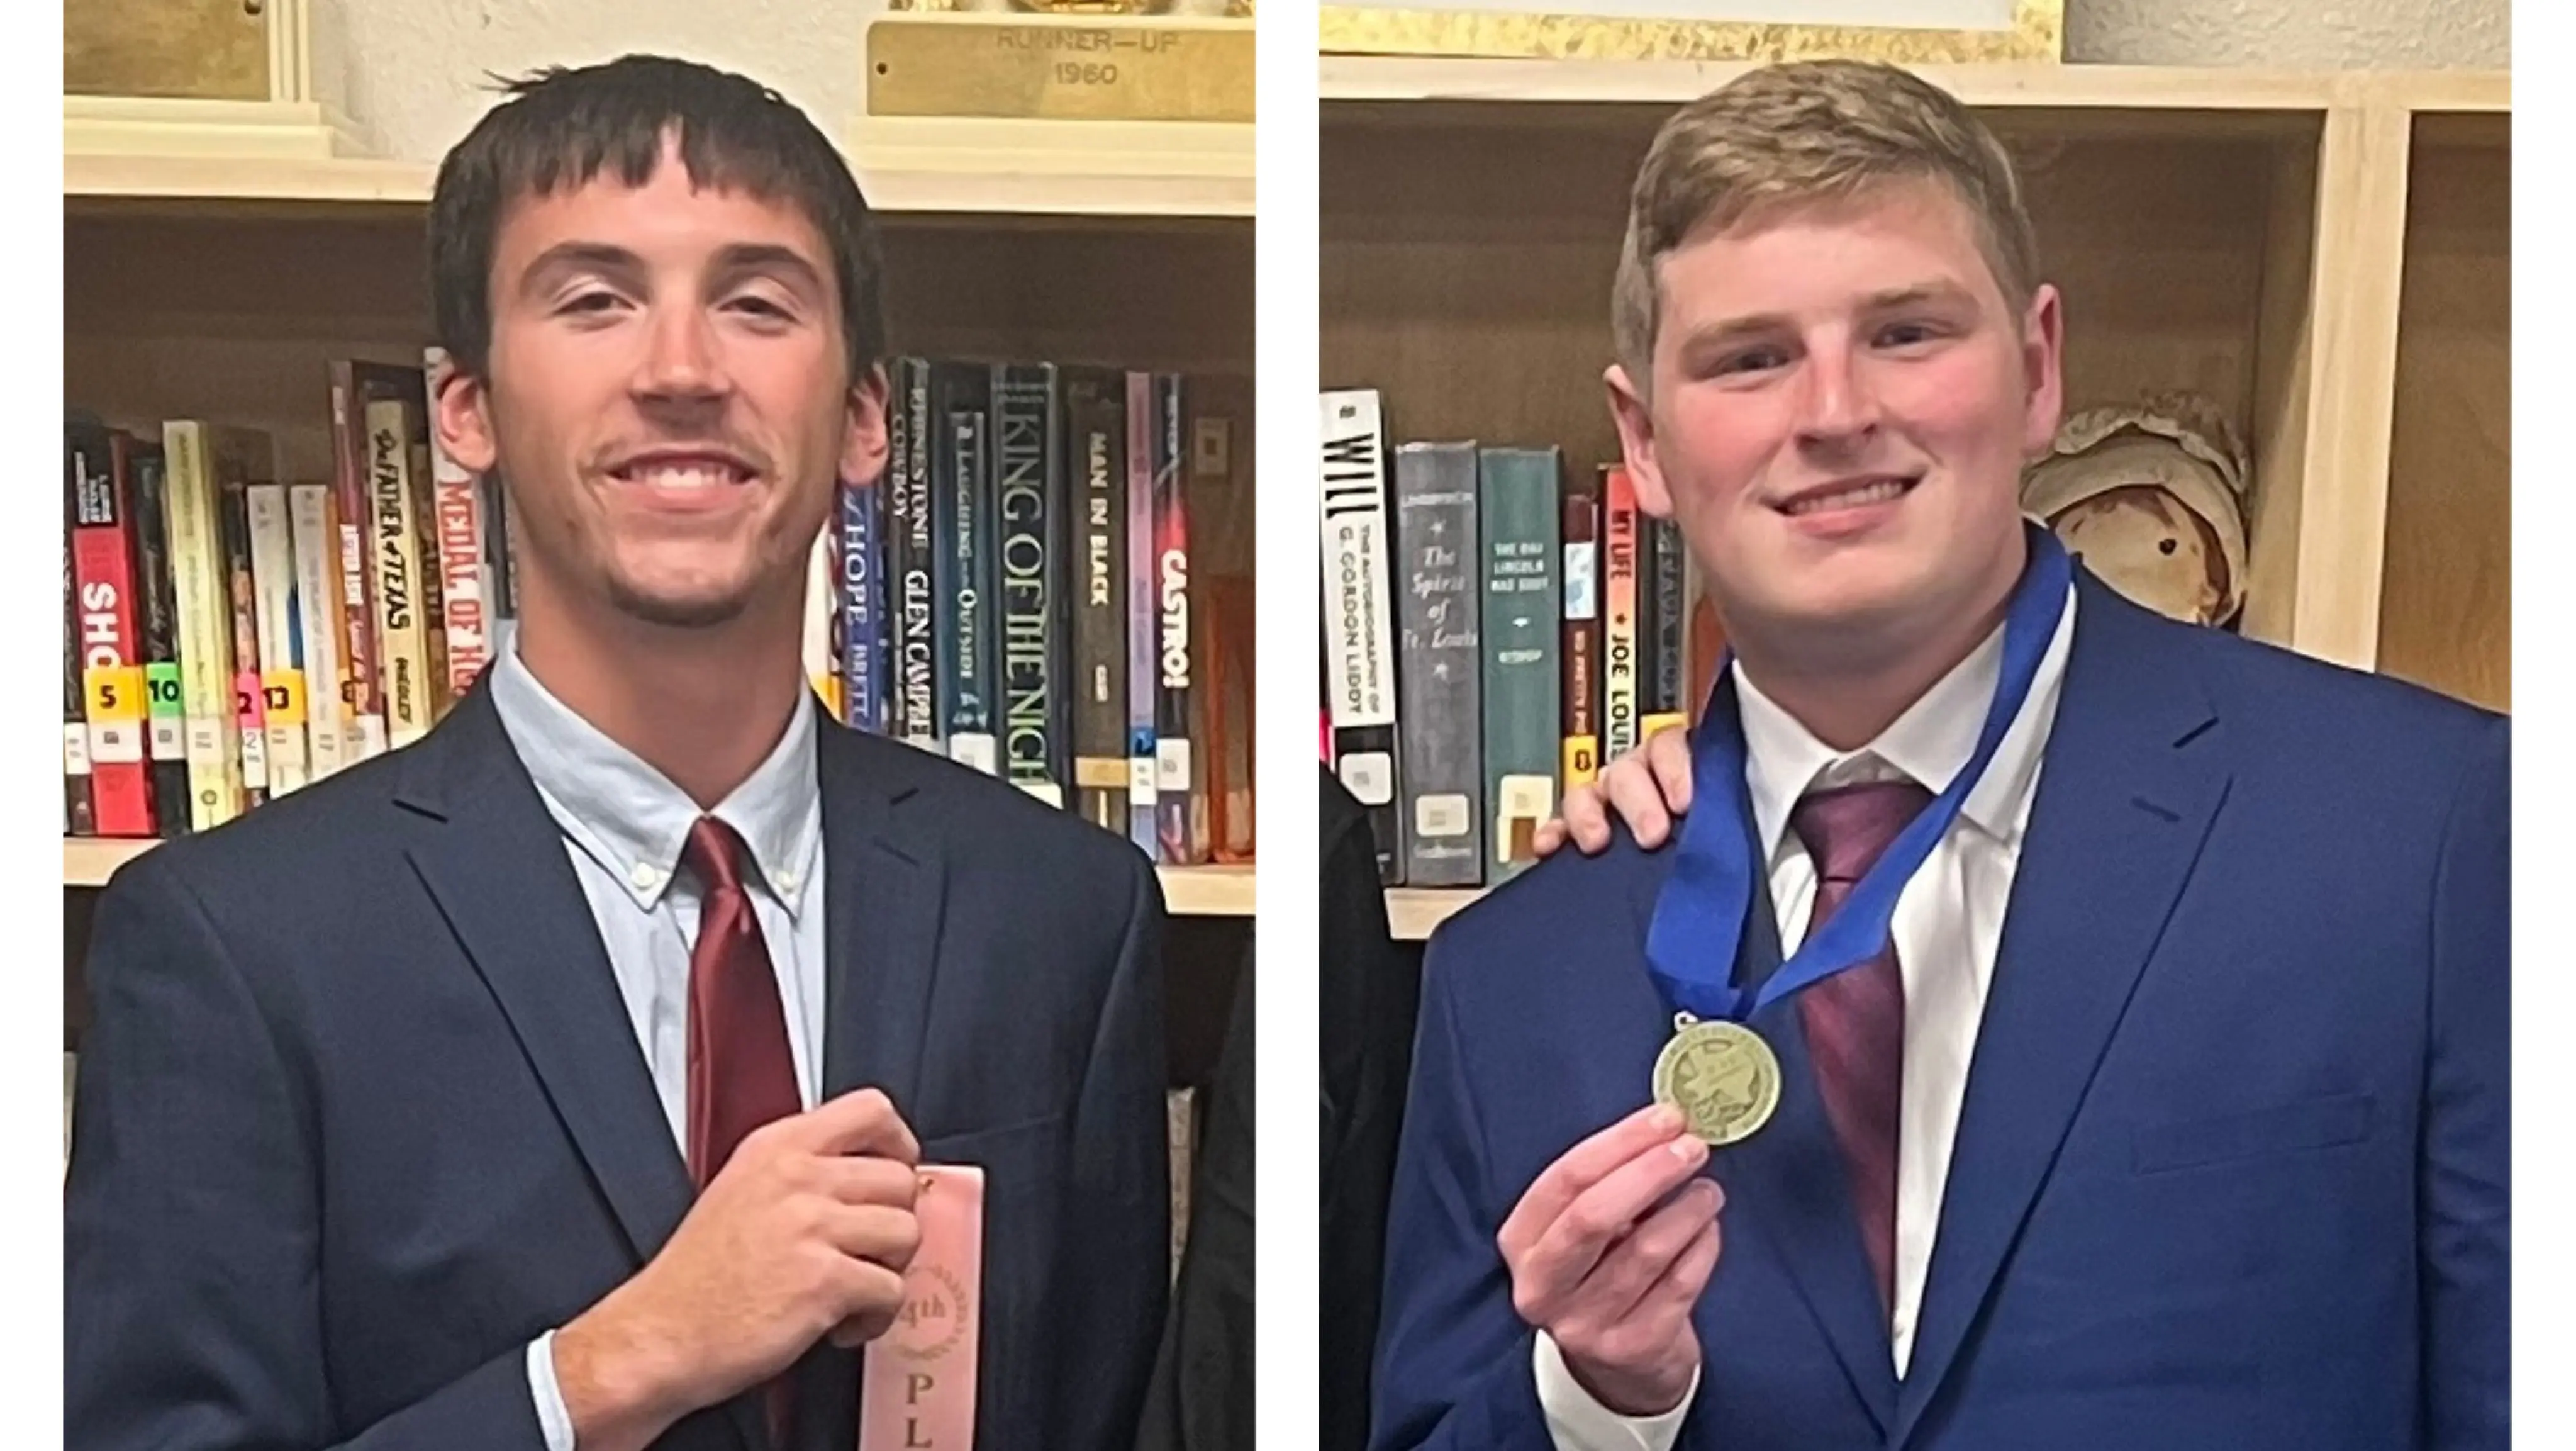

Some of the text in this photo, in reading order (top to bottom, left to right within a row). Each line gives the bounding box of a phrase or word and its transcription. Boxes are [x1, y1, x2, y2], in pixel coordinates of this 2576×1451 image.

[1056, 62, 1117, 85] 1960
[376, 461, 404, 539] FATHER
[1003, 413, 1043, 522] KING
[1322, 432, 1380, 520] WILL
[438, 481, 479, 589] MEDAL
[1090, 432, 1109, 606] MAN IN BLACK
[1424, 545, 1456, 567] The
[1610, 510, 1632, 580] MY LIFE
[384, 554, 411, 630] TEXAS
[844, 524, 868, 626] HOPE
[905, 569, 930, 637] GLEN
[1004, 532, 1044, 608] OF
[1411, 571, 1466, 599] Spirit
[82, 581, 121, 669] SHO
[449, 600, 483, 635] OF
[1006, 605, 1048, 680] THE
[1161, 549, 1190, 689] CASTRO!
[1339, 526, 1362, 714] G. GORDON LIDDY
[1427, 597, 1451, 625] of
[148, 680, 179, 702] 10
[450, 646, 486, 696] HO
[850, 644, 871, 719] BRETT
[1612, 633, 1629, 678] JOE
[99, 685, 117, 709] 5
[263, 685, 289, 710] 13
[1006, 683, 1052, 785] NIGH
[899, 1292, 947, 1330] 4th
